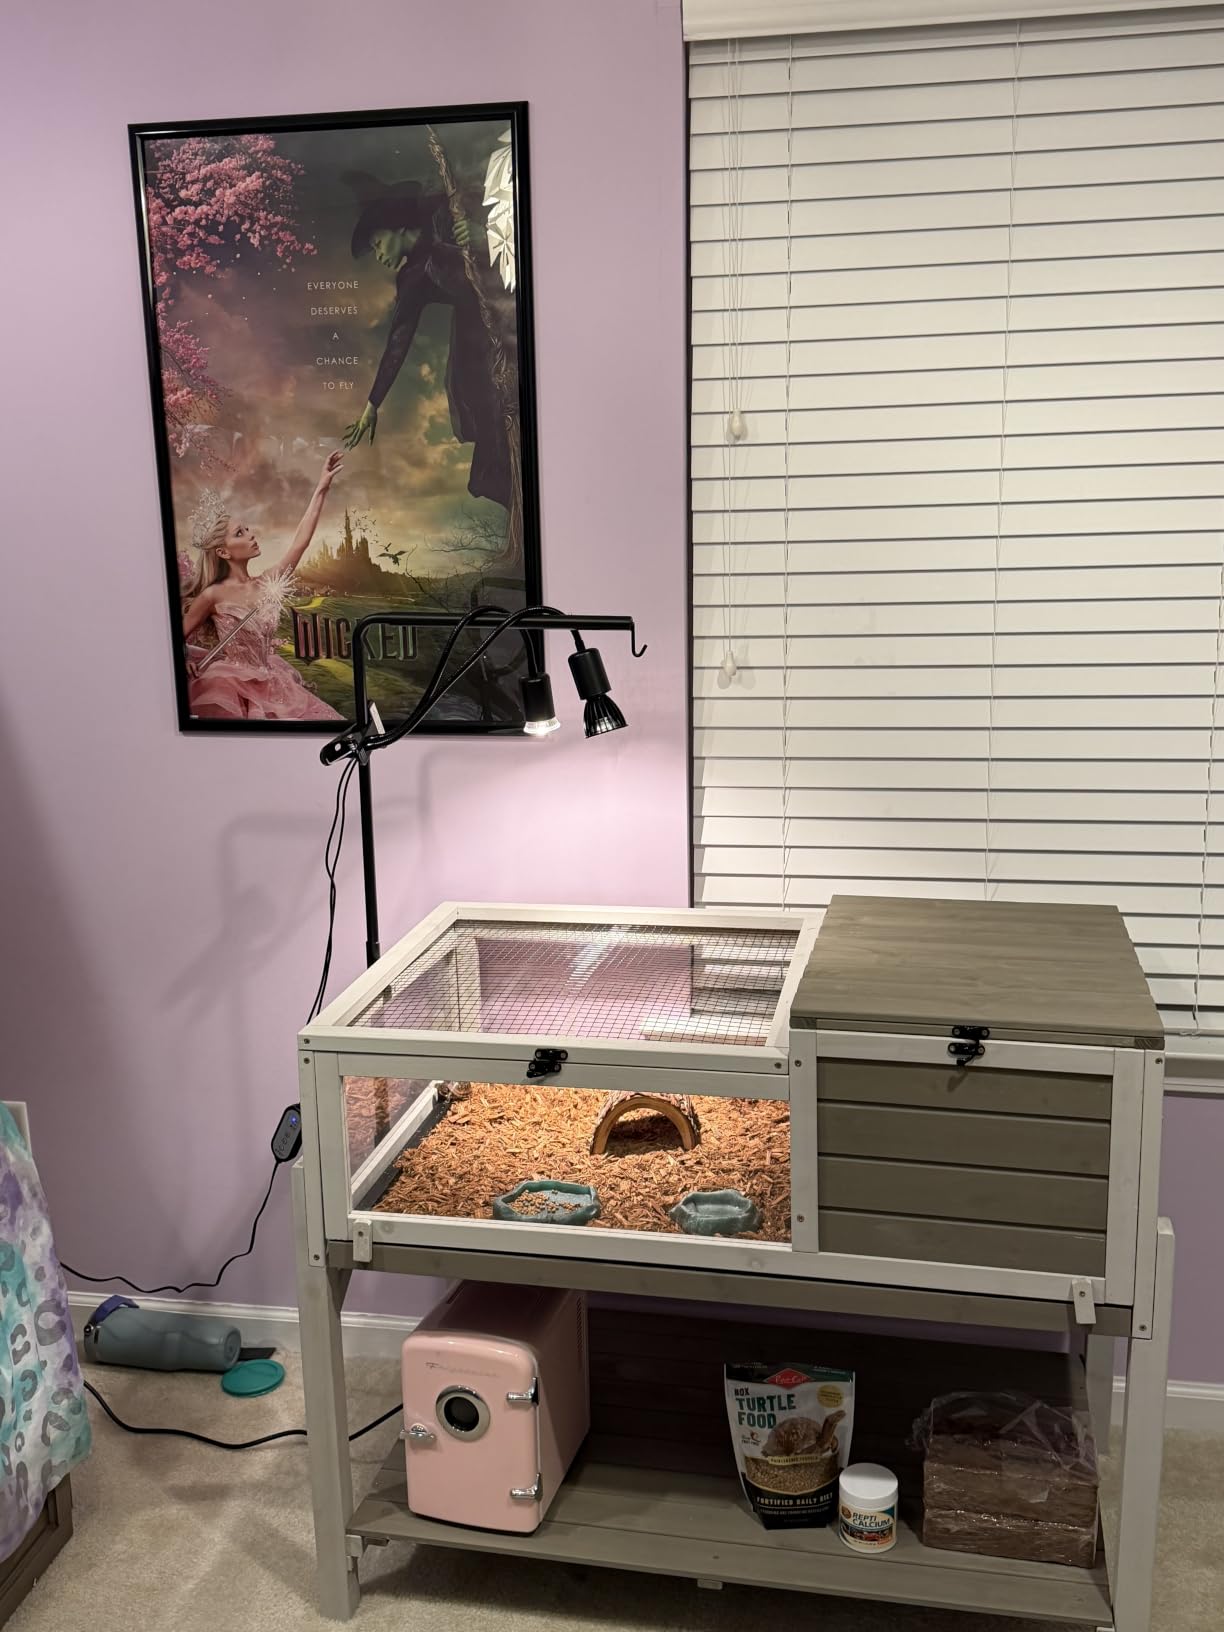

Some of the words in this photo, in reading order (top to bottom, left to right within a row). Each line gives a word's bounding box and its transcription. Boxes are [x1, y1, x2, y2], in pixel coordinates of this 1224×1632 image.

[307, 280, 359, 290] EVERYONE
[310, 305, 358, 316] DESERVES
[332, 332, 340, 341] A
[316, 356, 359, 366] CHANCE
[323, 381, 335, 390] TO
[339, 381, 354, 390] FLY
[734, 1387, 750, 1397] BOX
[735, 1393, 797, 1413] TURTLE
[737, 1411, 777, 1430] FOOD
[852, 1512, 877, 1522] REPTI
[852, 1518, 890, 1528] CALCIUM
